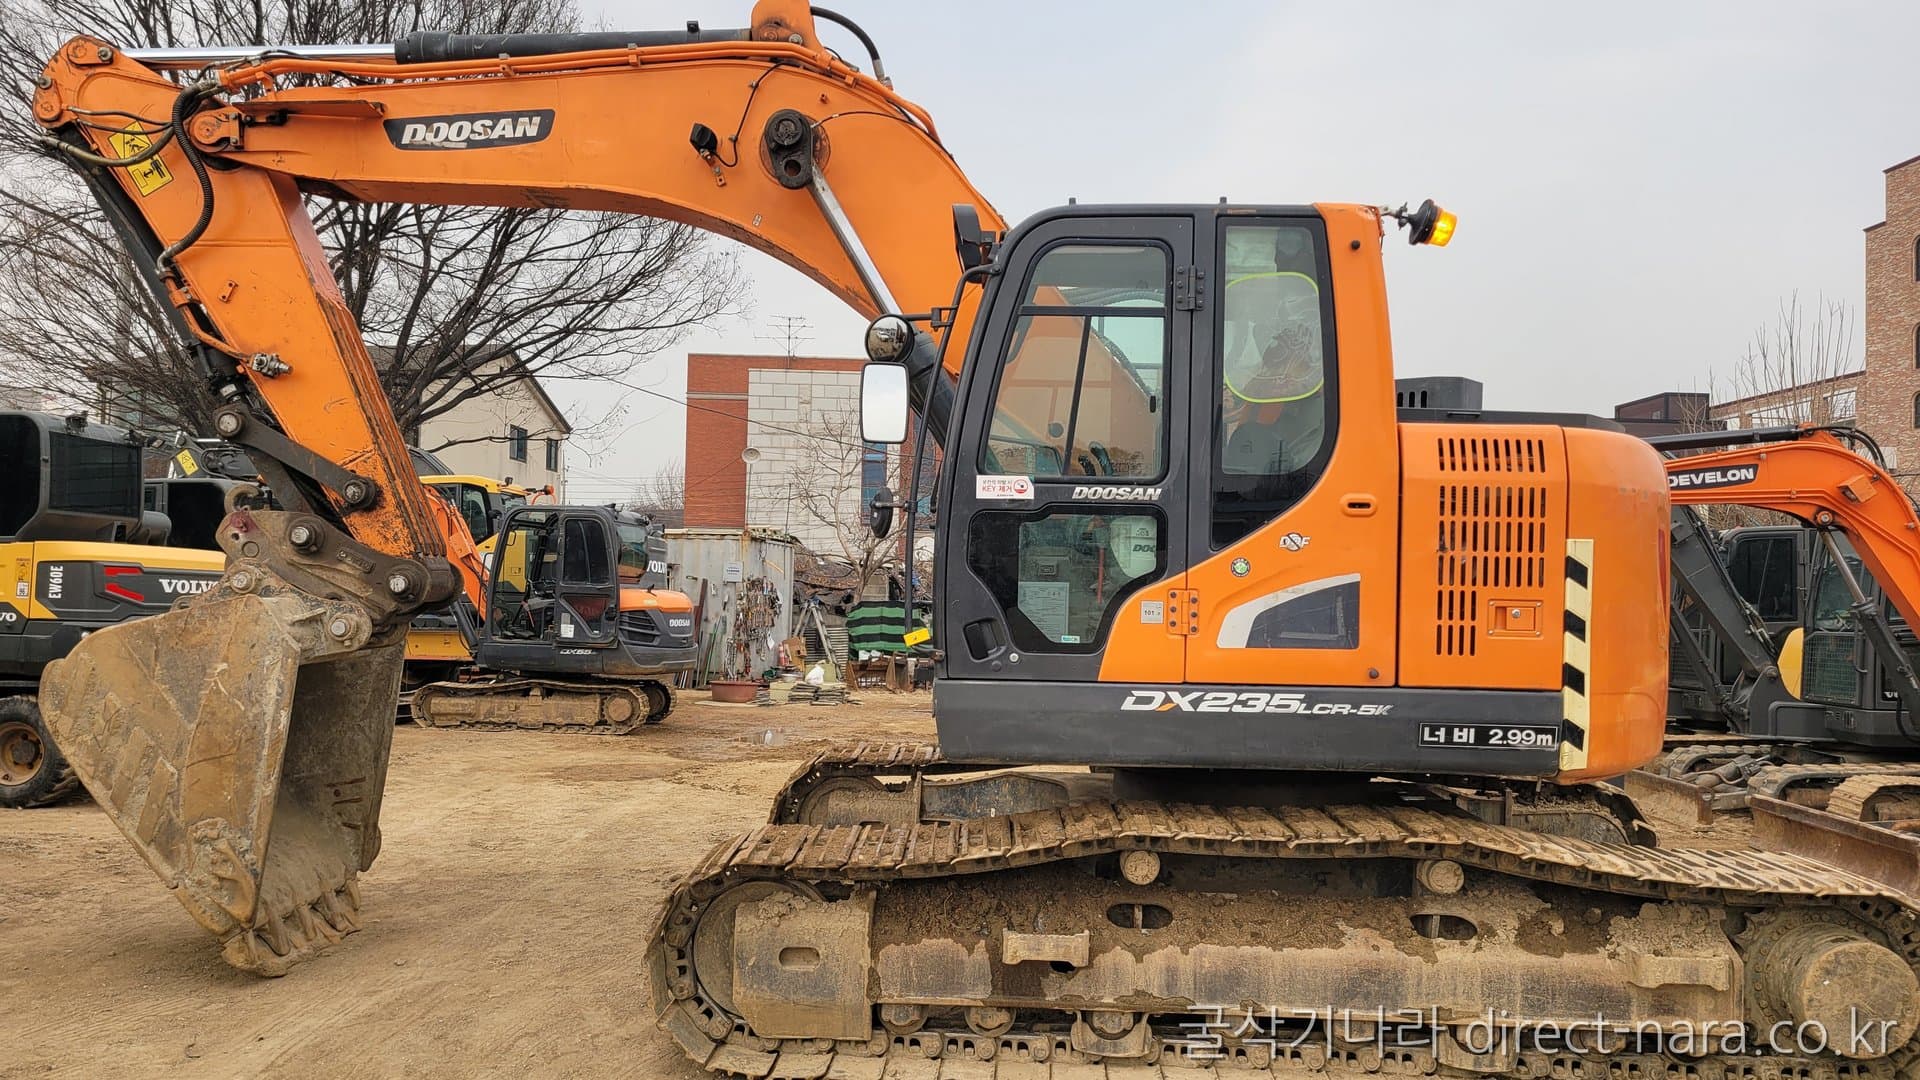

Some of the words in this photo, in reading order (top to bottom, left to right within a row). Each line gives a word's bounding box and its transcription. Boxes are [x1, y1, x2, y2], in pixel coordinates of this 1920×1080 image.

[401, 116, 541, 146] DOOSAN
[1667, 468, 1754, 487] DEVELON
[1072, 486, 1162, 500] DOOSAN
[48, 565, 64, 599] EW60E
[159, 578, 219, 594] VOLV
[1120, 690, 1395, 716] DX235LCR-5K
[1488, 729, 1553, 746] 2.99m
